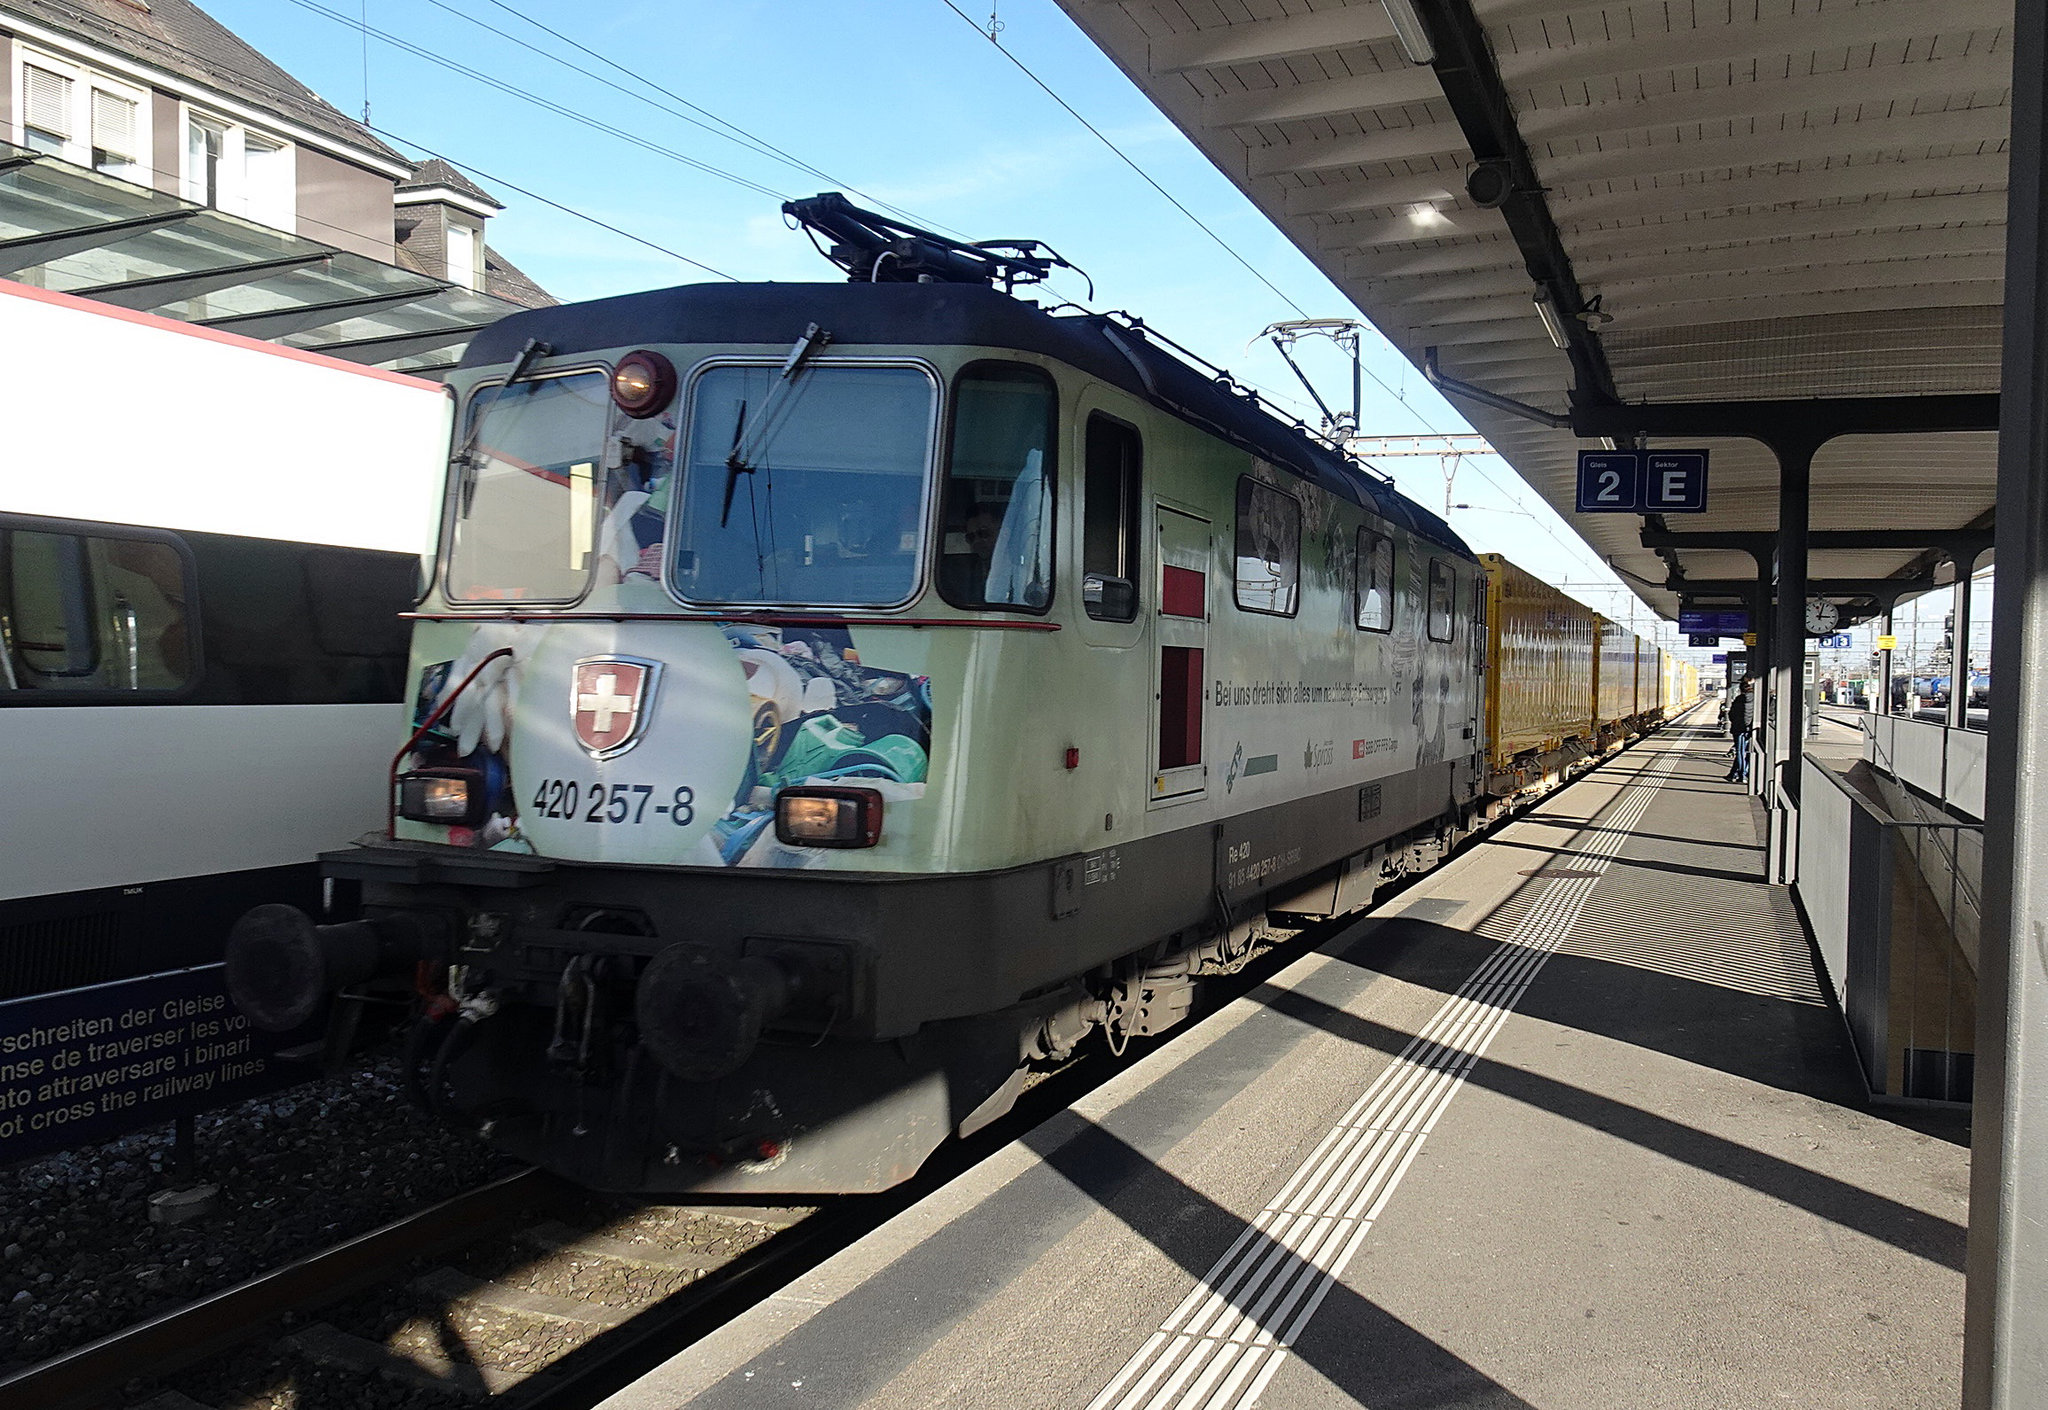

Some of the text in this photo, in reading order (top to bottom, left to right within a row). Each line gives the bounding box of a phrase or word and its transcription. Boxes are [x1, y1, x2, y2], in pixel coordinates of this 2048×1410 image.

[1590, 461, 1608, 469] Gleis
[1655, 461, 1679, 469] Sektor
[1597, 470, 1620, 502] 2
[1662, 471, 1687, 502] E
[1692, 637, 1700, 645] 2
[1707, 637, 1716, 645] D
[1840, 635, 1848, 647] 3
[1215, 680, 1231, 706] Bei
[1234, 686, 1250, 706] uns
[1253, 681, 1274, 704] dreht
[1276, 681, 1292, 704] sich
[1293, 681, 1310, 704] alles
[532, 779, 694, 827] 420 257-8
[1229, 841, 1252, 865] Re 420
[0, 993, 226, 1054] schreiten der Gleise
[0, 1058, 45, 1081] nse
[51, 1050, 83, 1071] de
[87, 1026, 185, 1064] traverser
[190, 1019, 220, 1042] les
[37, 1056, 177, 1103] attraversare
[184, 1048, 190, 1068] i
[195, 1033, 251, 1065] binari
[0, 1056, 266, 1139] ot cross the railway lines
